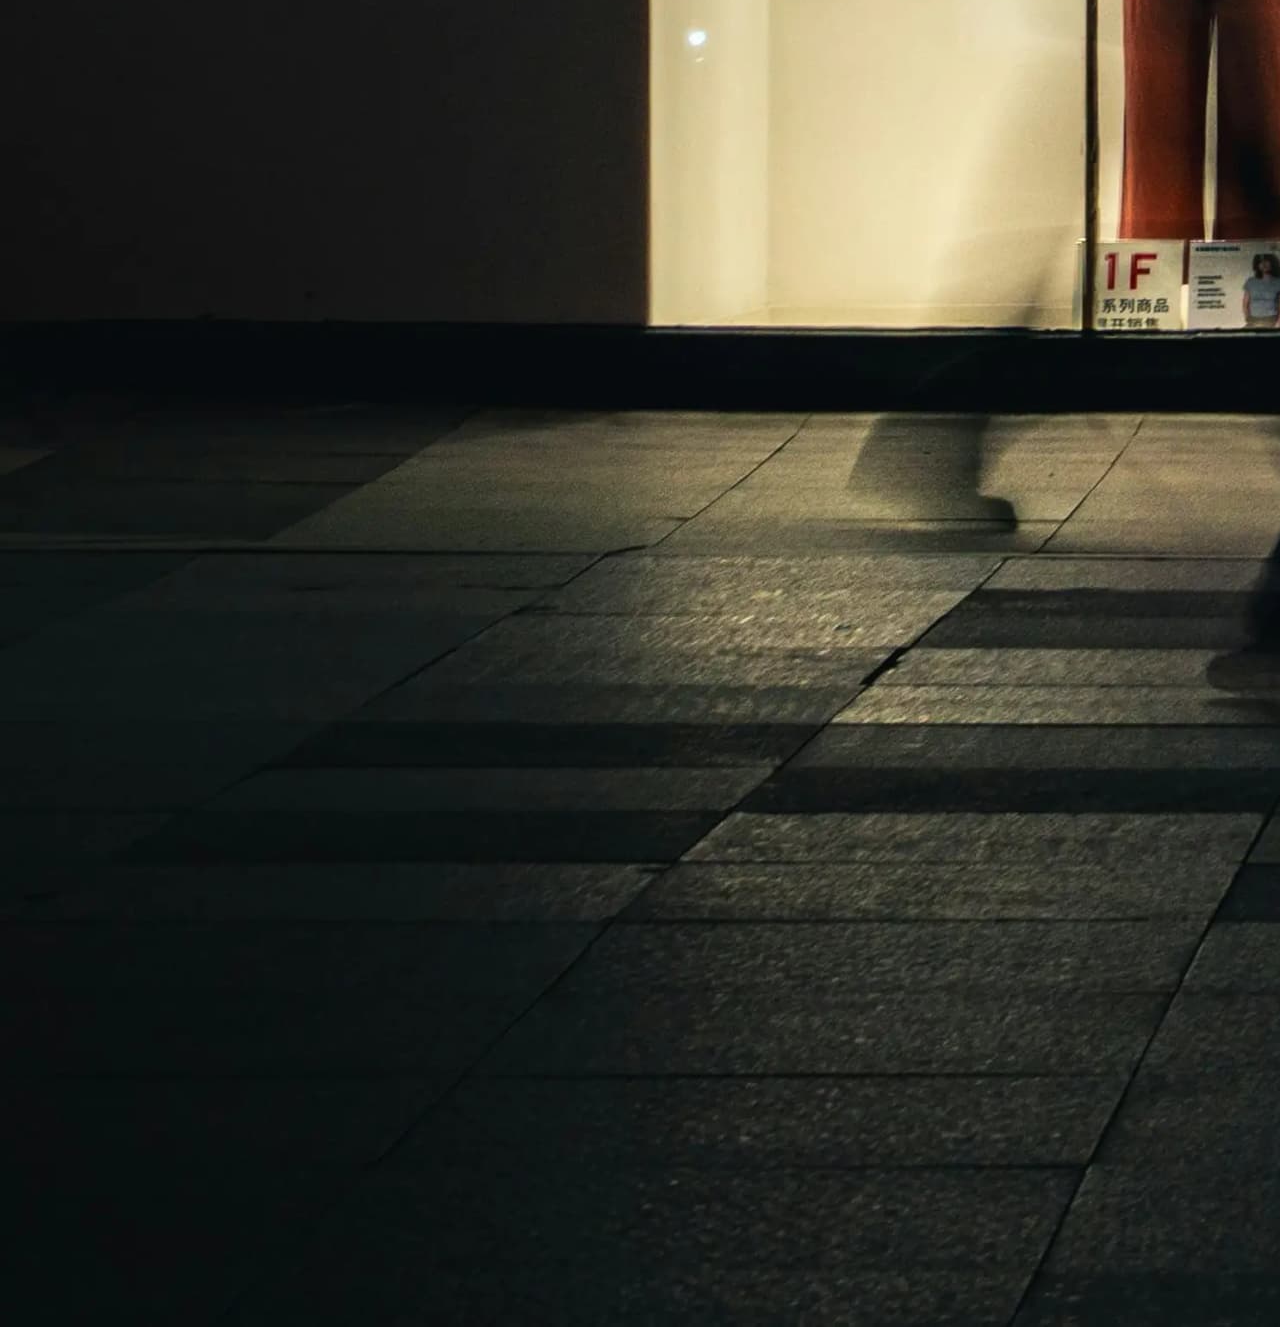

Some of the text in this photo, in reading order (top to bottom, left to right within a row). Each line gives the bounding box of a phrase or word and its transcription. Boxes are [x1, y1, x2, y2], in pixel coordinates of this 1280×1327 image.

[1104, 253, 1158, 290] 1F
[1096, 298, 1169, 314] 系列商品
